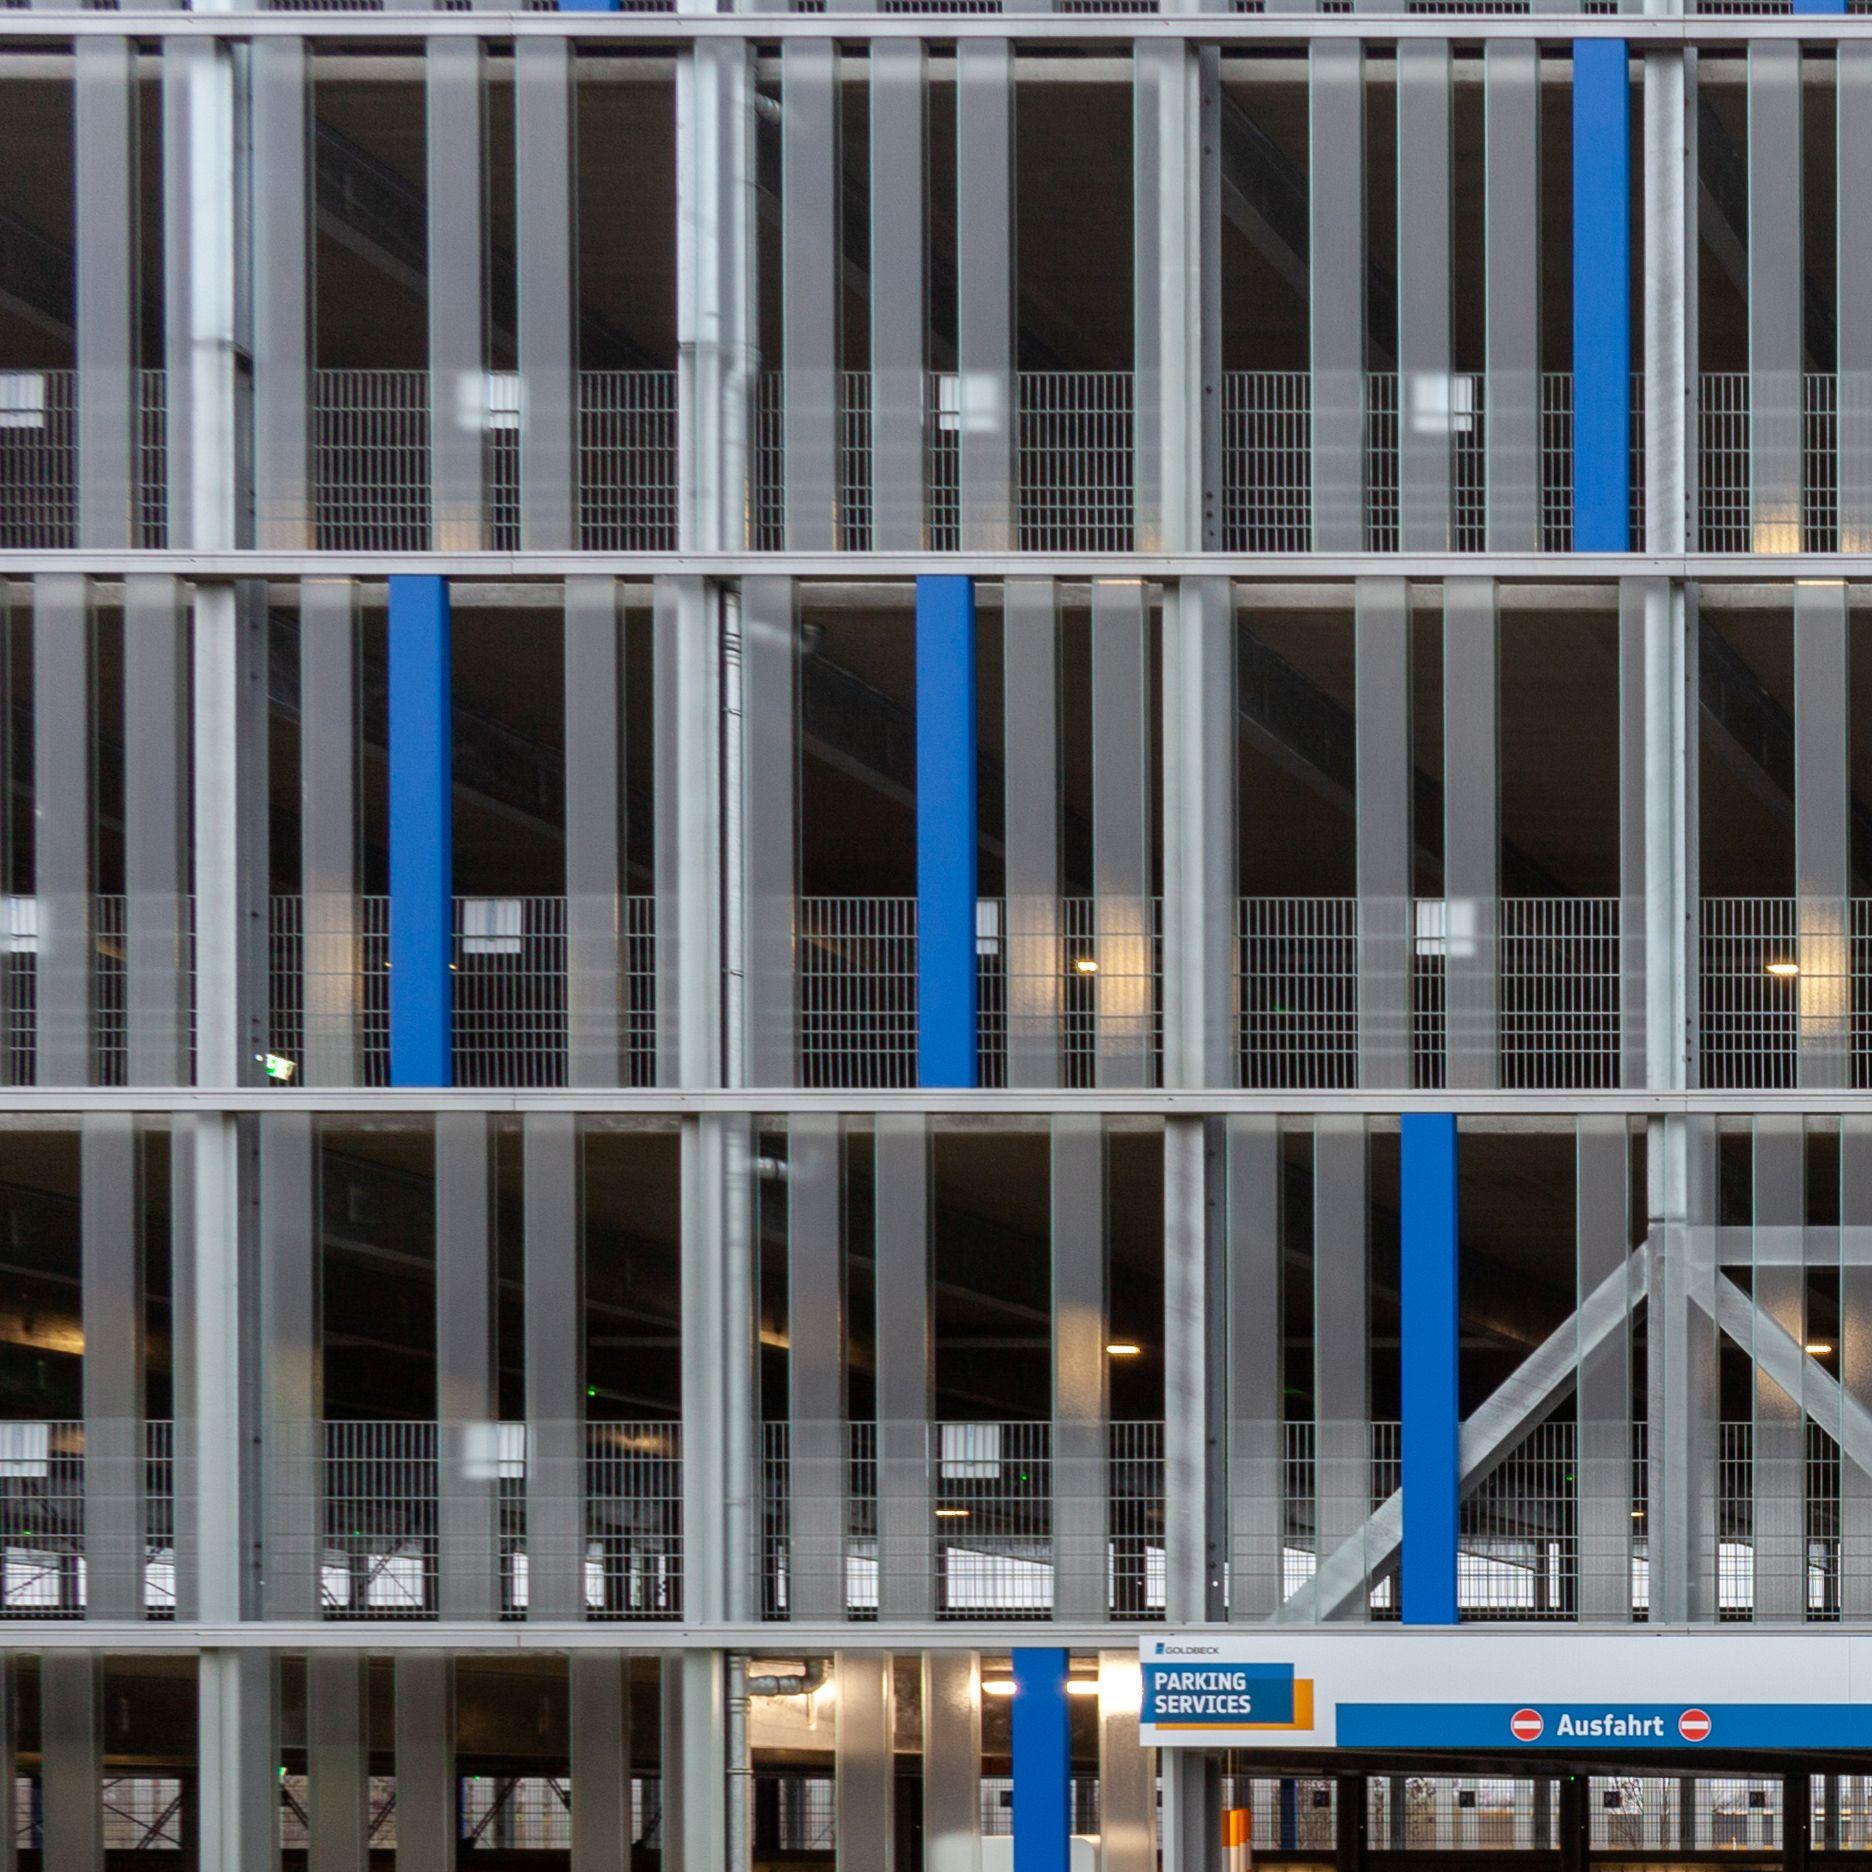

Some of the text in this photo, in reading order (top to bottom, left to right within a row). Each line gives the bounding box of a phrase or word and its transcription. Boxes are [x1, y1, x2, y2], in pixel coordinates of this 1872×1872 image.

[1165, 1646, 1220, 1655] GOLDBECK
[1154, 1672, 1247, 1691] PARKING
[1154, 1695, 1251, 1714] SERVICES
[1556, 1714, 1664, 1737] Ausfahrt
